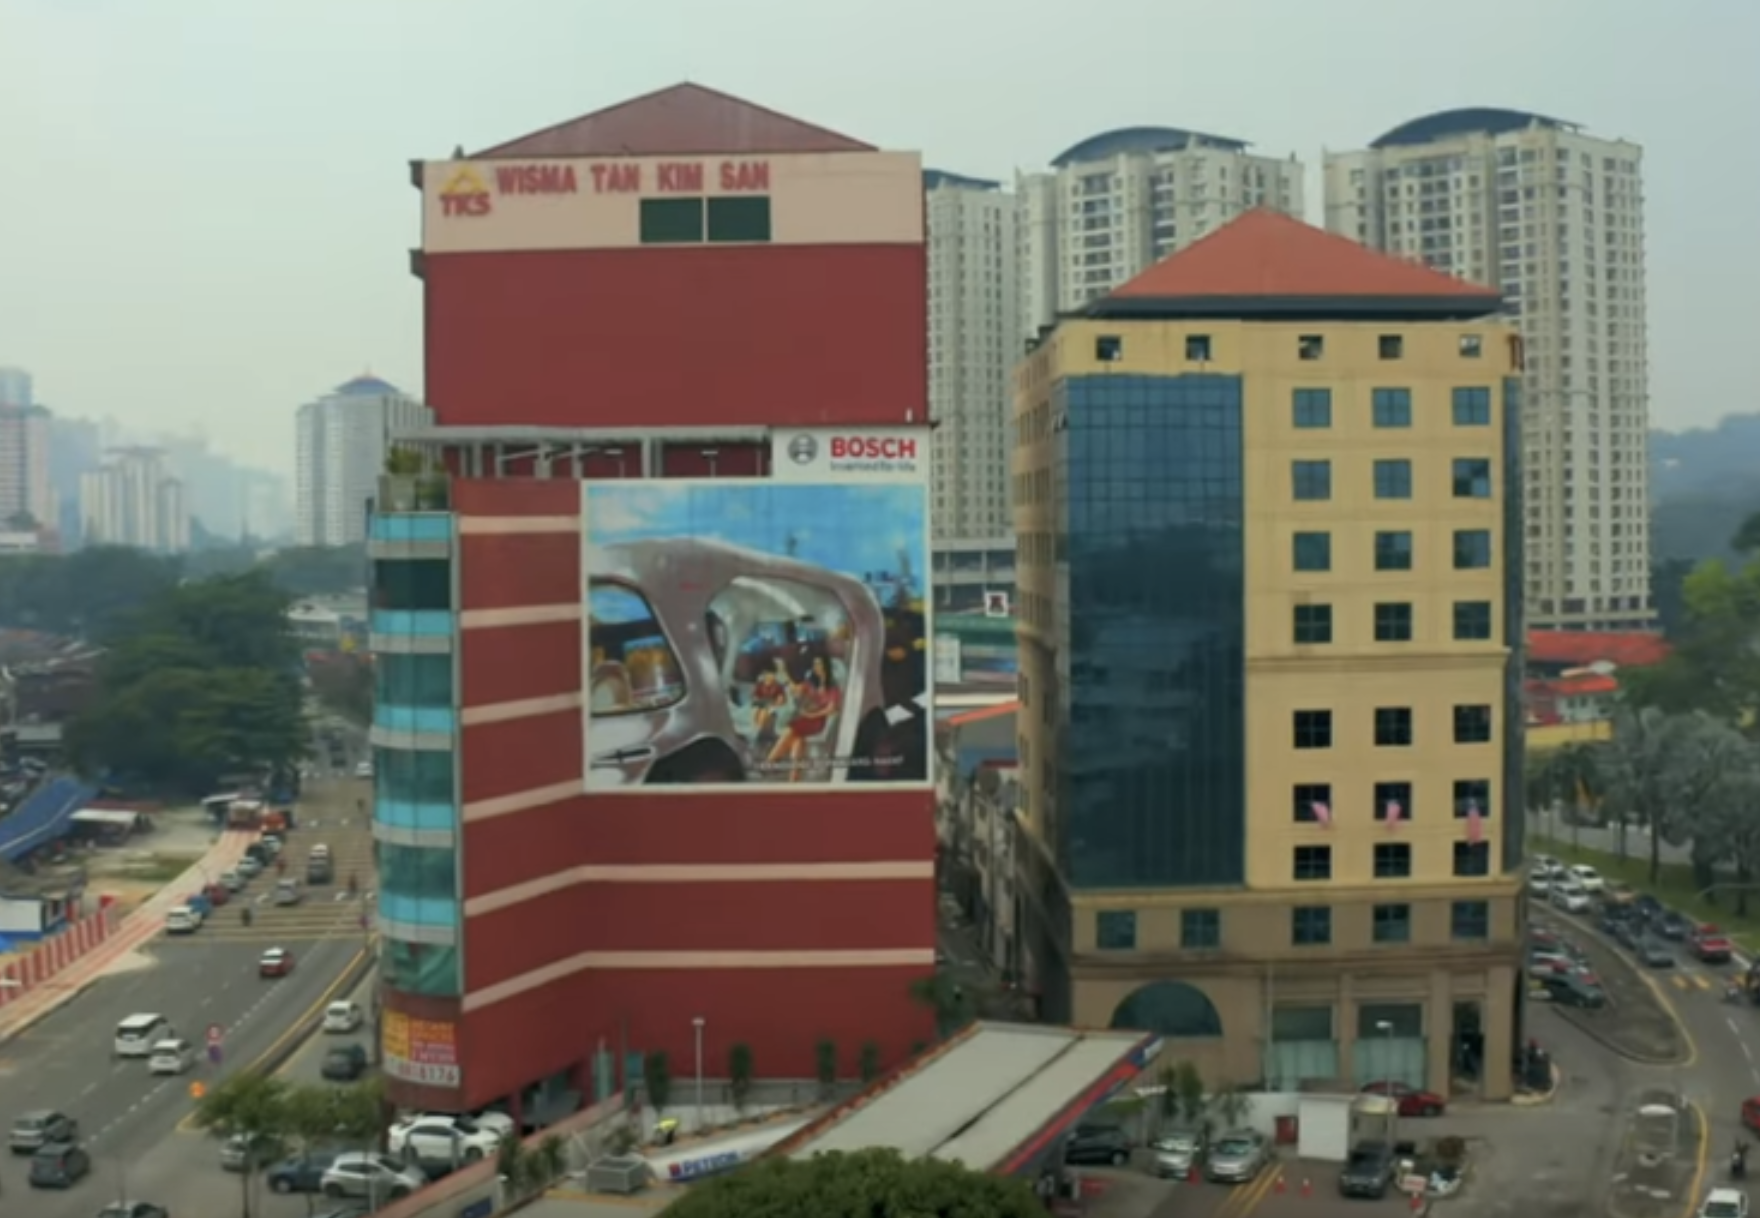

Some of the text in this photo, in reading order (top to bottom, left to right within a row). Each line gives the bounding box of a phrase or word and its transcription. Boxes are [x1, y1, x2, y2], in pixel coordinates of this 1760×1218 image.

[496, 160, 769, 195] WISMA TAN KIM SAN
[439, 193, 491, 217] TKS
[830, 436, 915, 459] BOSCH
